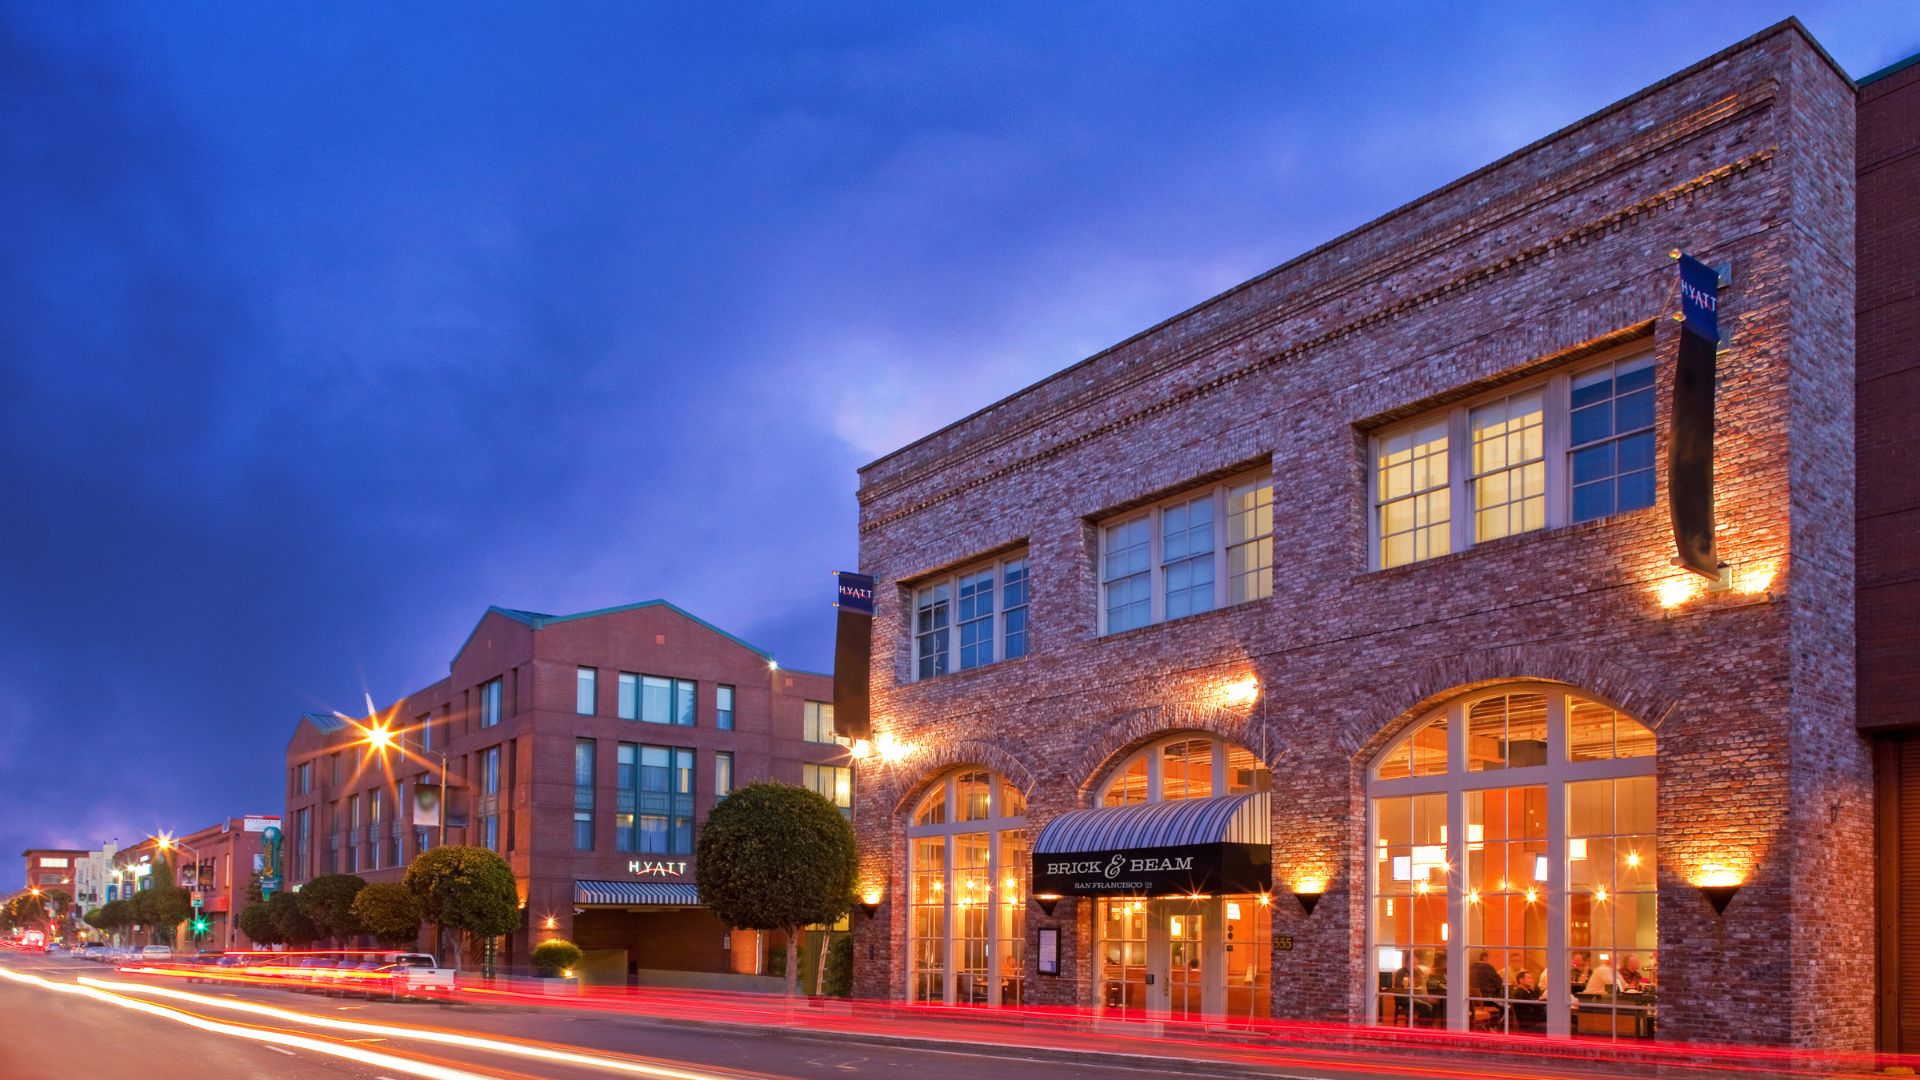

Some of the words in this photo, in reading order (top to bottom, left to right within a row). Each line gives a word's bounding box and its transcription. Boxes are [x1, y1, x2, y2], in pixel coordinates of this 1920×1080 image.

[1681, 279, 1717, 312] HYATT
[839, 585, 872, 599] HYATT
[628, 860, 687, 877] HYATT
[1046, 861, 1102, 875] BRICK
[1104, 854, 1126, 879] &
[1129, 857, 1194, 872] BEAM
[1092, 881, 1143, 889] FRANCISCO
